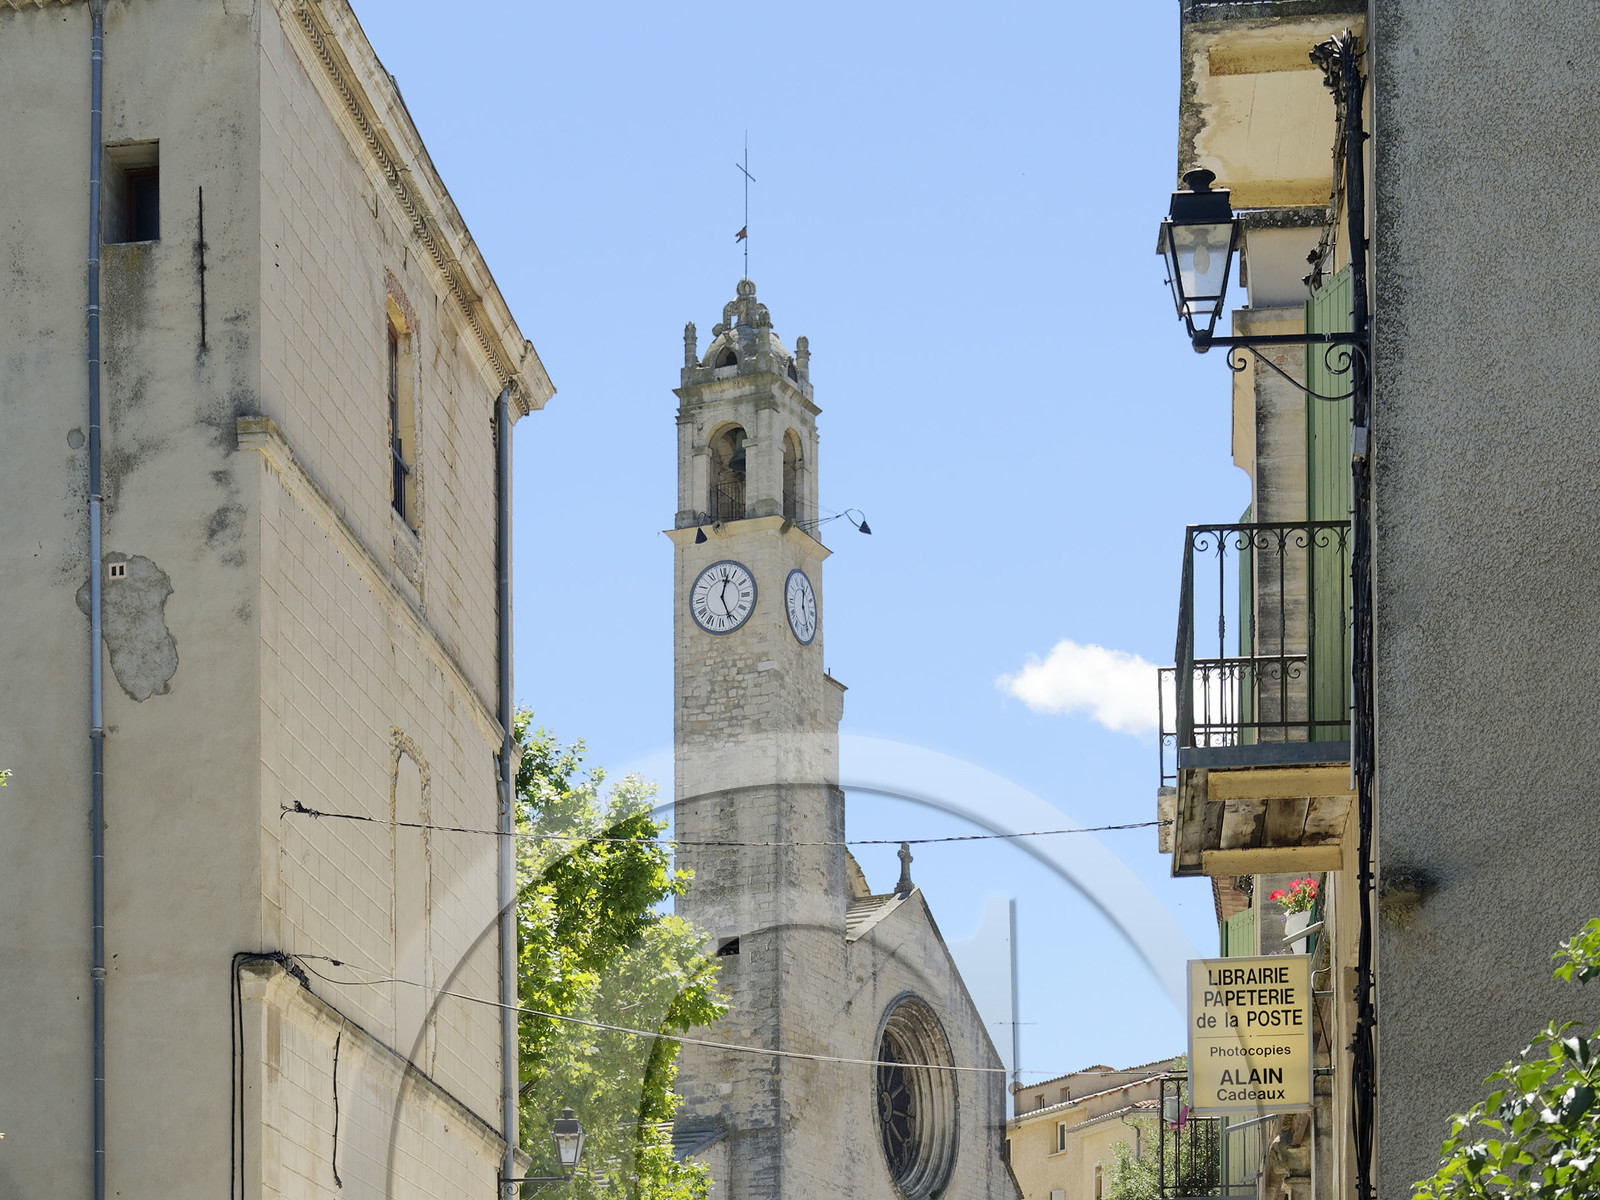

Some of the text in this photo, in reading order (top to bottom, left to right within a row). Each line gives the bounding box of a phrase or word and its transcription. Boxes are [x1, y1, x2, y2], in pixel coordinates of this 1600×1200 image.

[1208, 967, 1289, 986] LIBRAIRIE
[1204, 988, 1295, 1007] PAPETERIE
[1196, 1009, 1303, 1028] de la POSTE
[1210, 1045, 1291, 1057] Photocopies
[1220, 1068, 1283, 1086] ALAIN
[1216, 1088, 1286, 1101] Cadeaux
